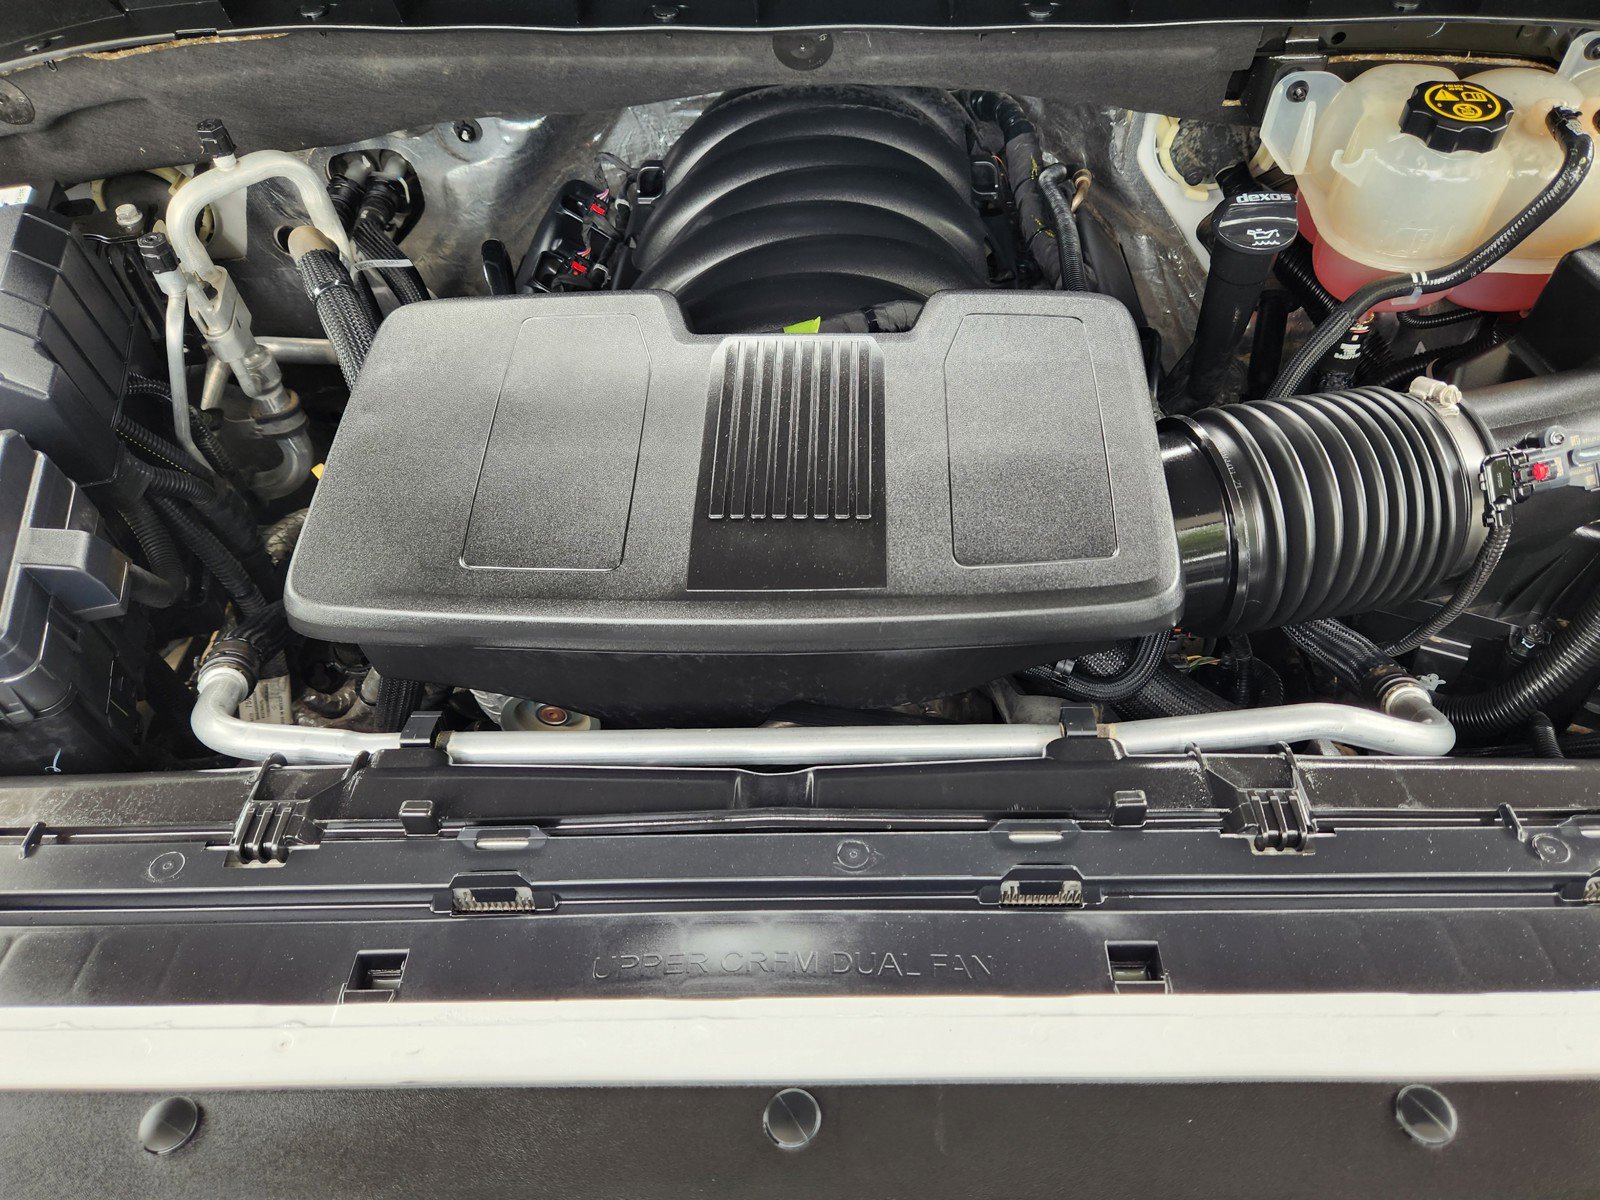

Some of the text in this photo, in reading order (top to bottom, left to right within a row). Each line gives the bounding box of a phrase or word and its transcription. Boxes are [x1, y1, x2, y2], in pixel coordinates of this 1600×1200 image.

[1236, 193, 1292, 204] dexos
[592, 951, 993, 979] UPPER CRFM DUAL FAN
